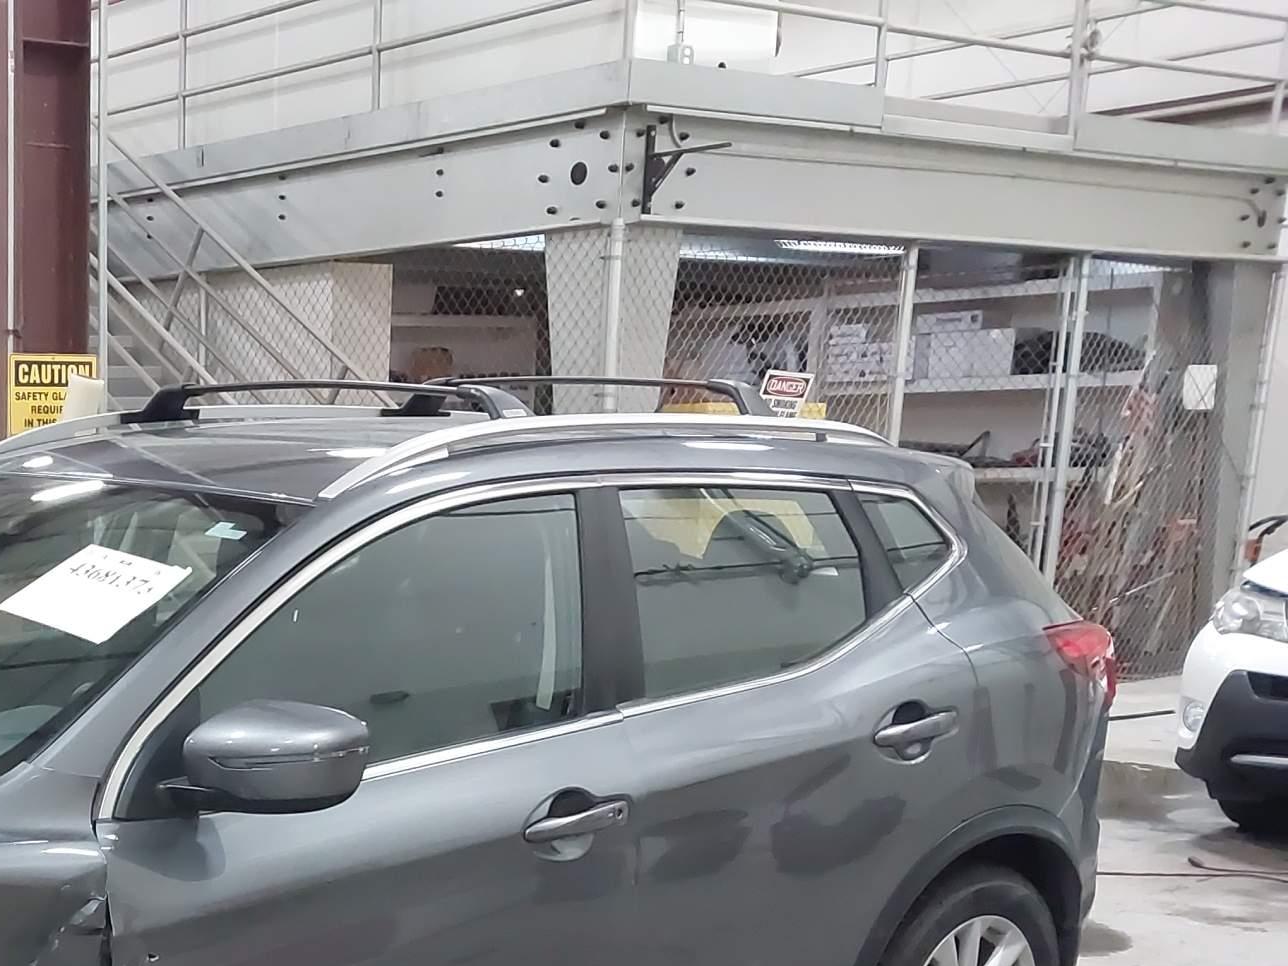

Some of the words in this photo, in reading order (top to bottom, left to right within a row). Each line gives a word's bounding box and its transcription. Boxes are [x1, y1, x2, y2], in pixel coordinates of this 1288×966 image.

[769, 379, 804, 393] DANGER
[15, 391, 49, 401] SAFETY
[24, 418, 34, 428] IN
